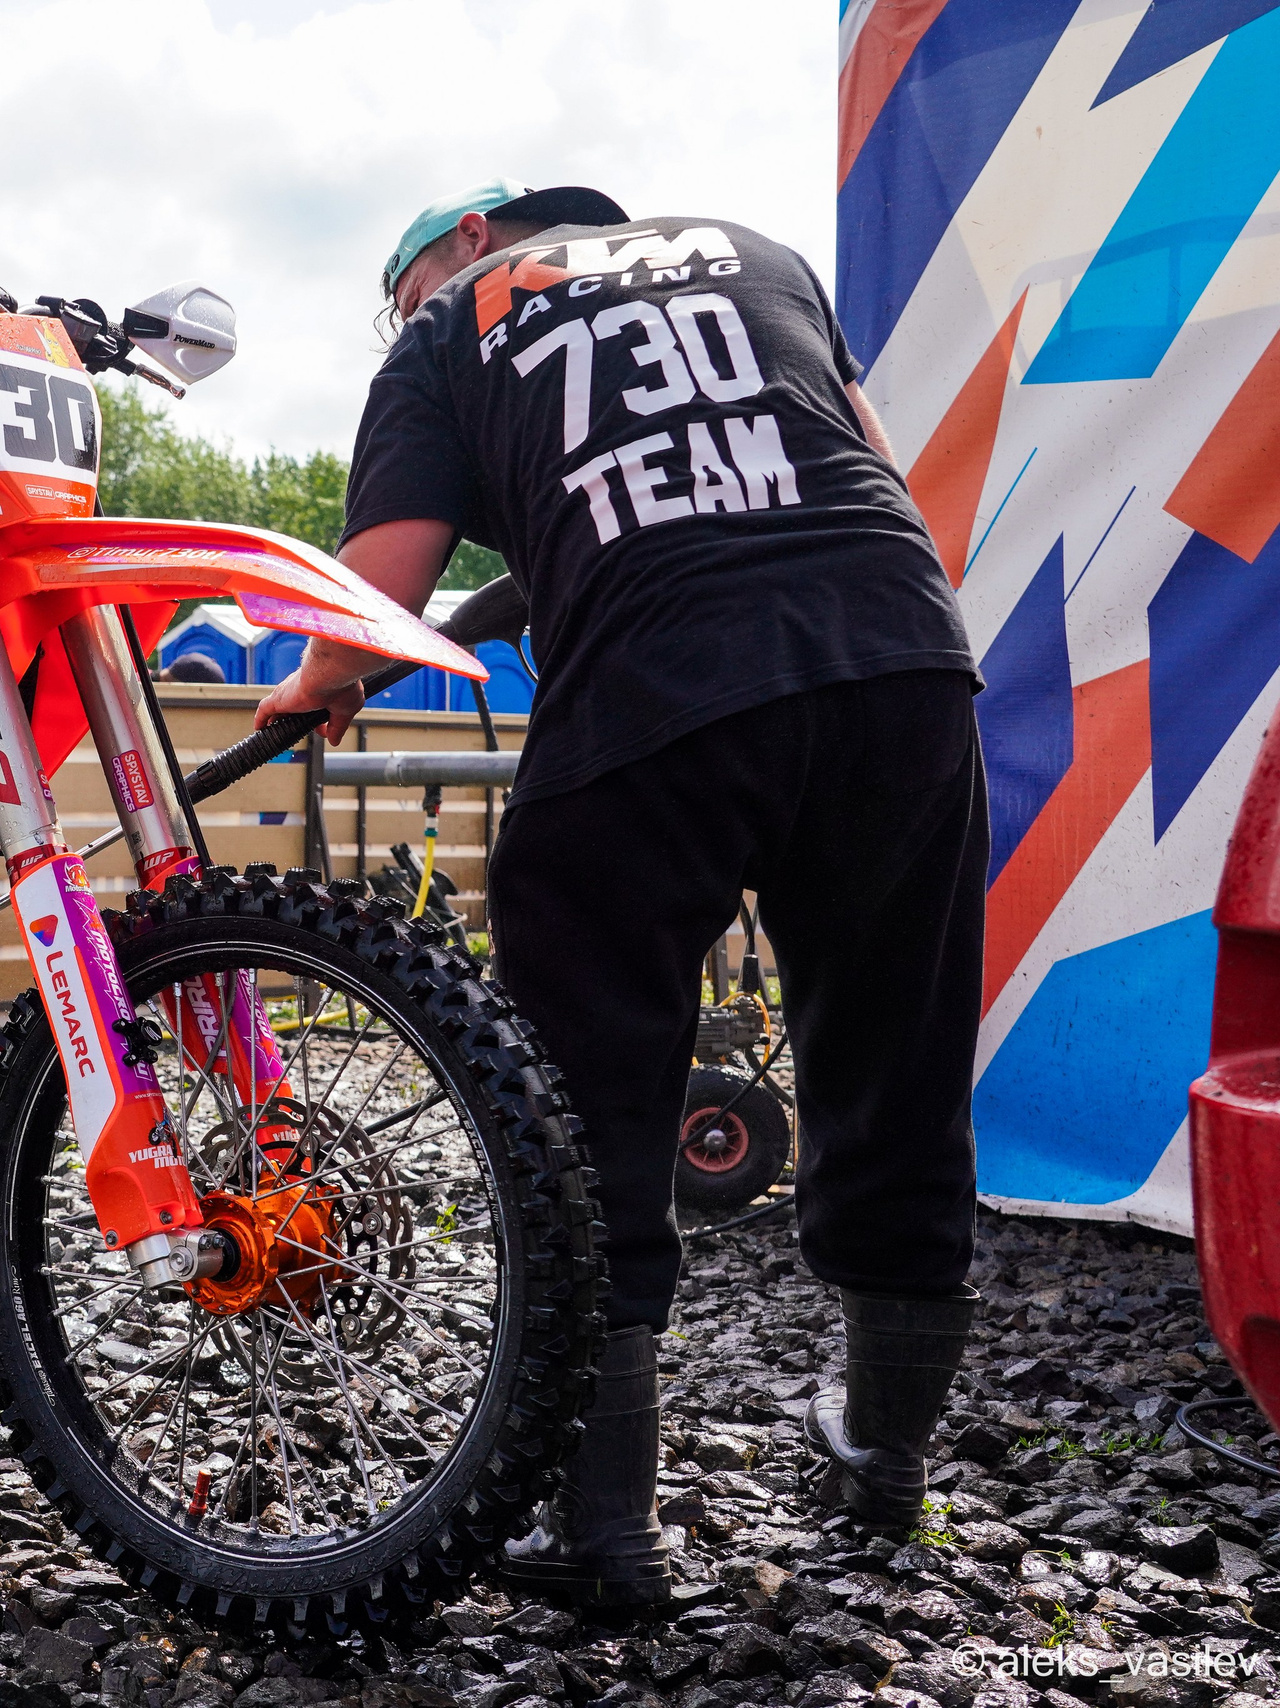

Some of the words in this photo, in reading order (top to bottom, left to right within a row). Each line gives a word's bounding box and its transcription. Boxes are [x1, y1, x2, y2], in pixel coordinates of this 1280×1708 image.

[474, 227, 738, 337] KTM
[480, 259, 741, 365] RACING
[511, 293, 765, 454] 730
[55, 491, 87, 503] GRAPHICS
[562, 414, 801, 545] TEAM
[112, 757, 136, 812] GRAPHICS
[124, 753, 150, 803] SPYSTAV
[46, 951, 96, 1078] LEMARC
[128, 1145, 173, 1164] YUGRA
[21, 1323, 42, 1369] EXCEL
